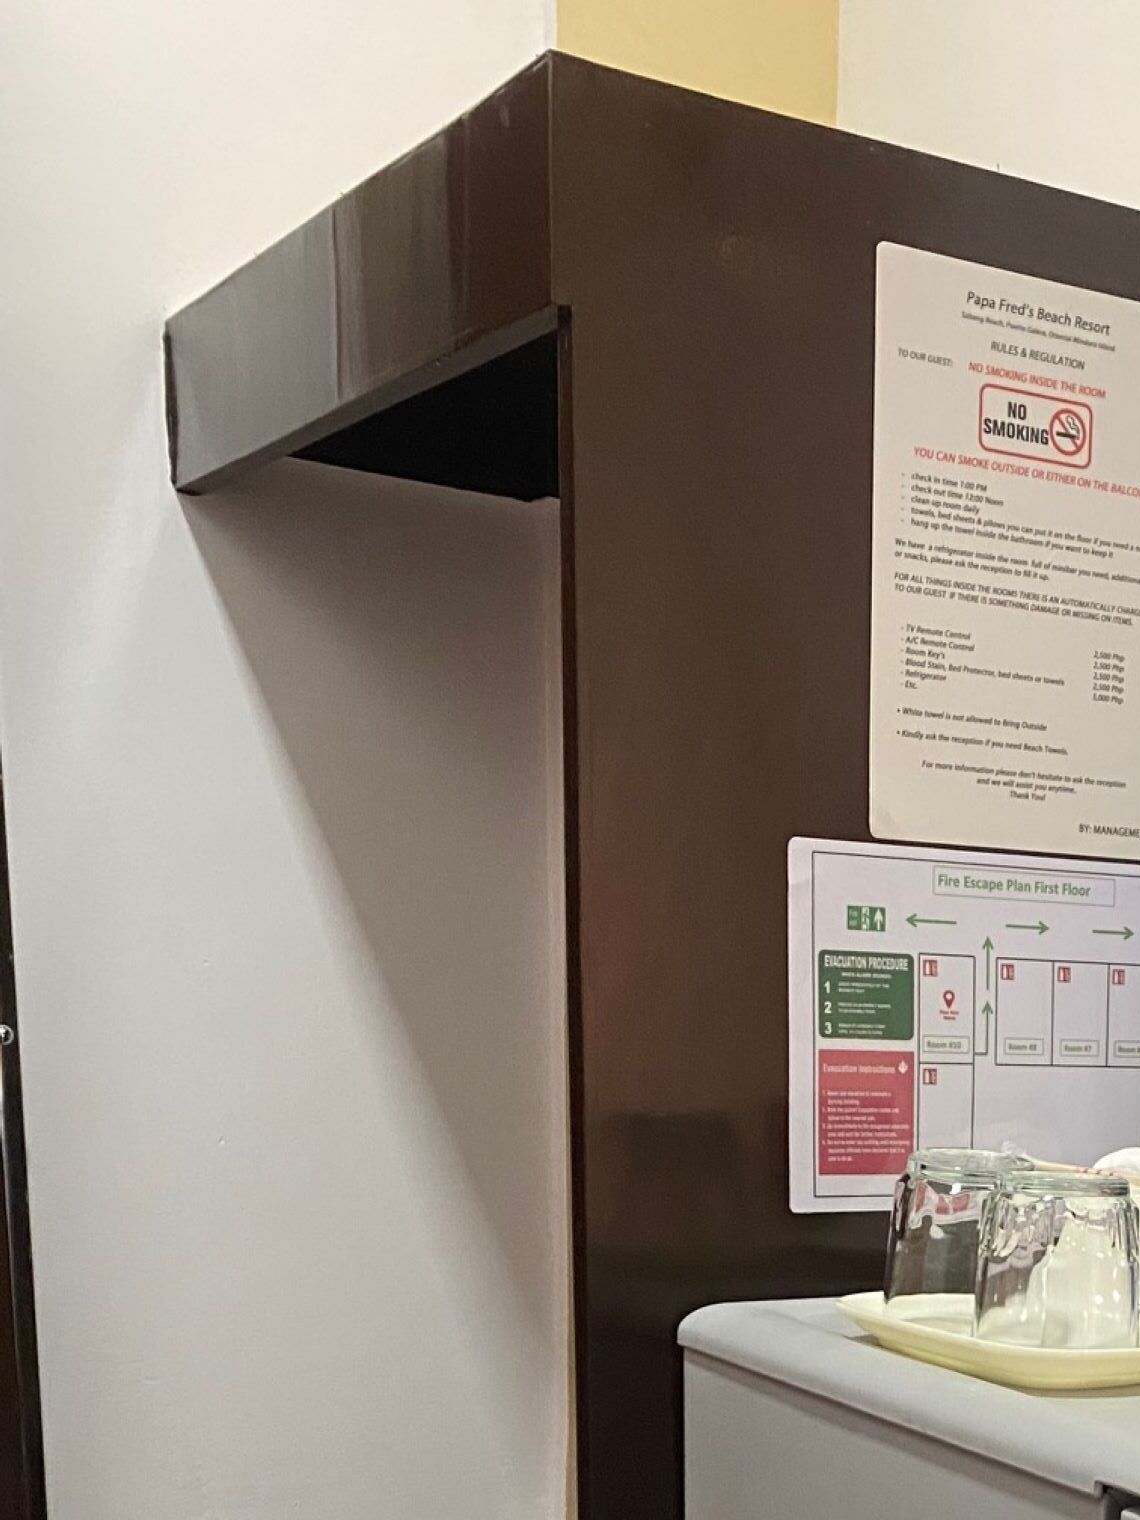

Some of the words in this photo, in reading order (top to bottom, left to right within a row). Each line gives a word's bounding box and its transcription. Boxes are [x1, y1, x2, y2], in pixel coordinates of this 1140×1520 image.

[966, 292, 995, 309] Papa
[998, 298, 1033, 318] Fred's
[1036, 308, 1071, 326] Beach
[1074, 316, 1110, 335] Resort
[898, 348, 908, 357] TO
[910, 350, 926, 361] OUR
[990, 340, 1018, 356] RULES
[1020, 348, 1027, 357] &
[1028, 350, 1085, 370] REGULATION
[968, 362, 983, 373] NO
[984, 364, 1027, 383] SMOKING
[1028, 374, 1057, 389] INSIDE
[1060, 380, 1076, 393] THE
[1078, 384, 1106, 398] ROOM
[1008, 402, 1026, 420] NO
[984, 418, 1048, 445] SMOKING
[914, 446, 934, 459] YOU
[936, 450, 956, 463] CAN
[958, 454, 989, 470] SMOKE
[990, 460, 1029, 477] OUTSIDE
[1032, 468, 1044, 479] OR
[1046, 470, 1076, 485] EITHER
[1076, 478, 1091, 488] ON
[1094, 480, 1108, 491] THE
[1078, 824, 1093, 832] BY:
[938, 874, 960, 887] Fire
[964, 876, 1003, 891] Escape
[1007, 879, 1031, 893] Plan
[1035, 882, 1059, 895] First
[1062, 883, 1091, 897] Floor
[824, 955, 867, 969] EVACUATION
[869, 957, 909, 971] PROCEDURE
[824, 981, 831, 994] 1
[824, 1001, 832, 1014] 2
[824, 1022, 832, 1035] 3
